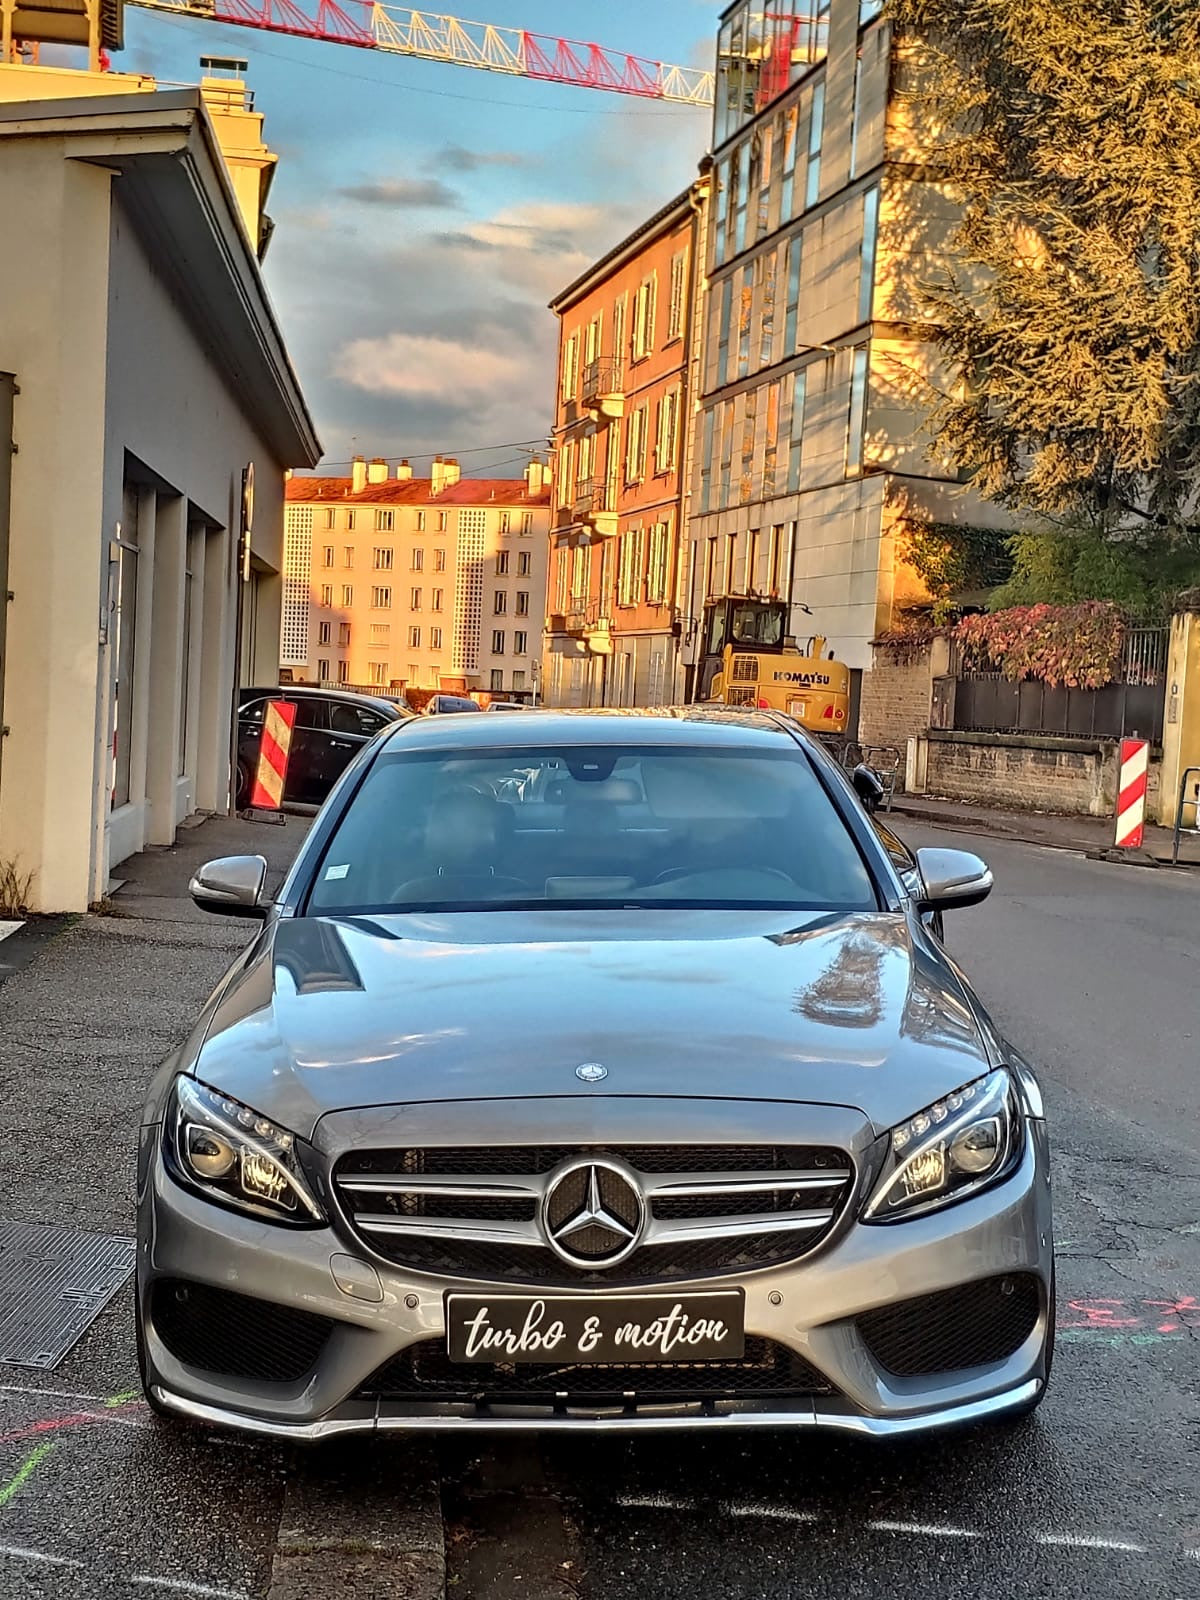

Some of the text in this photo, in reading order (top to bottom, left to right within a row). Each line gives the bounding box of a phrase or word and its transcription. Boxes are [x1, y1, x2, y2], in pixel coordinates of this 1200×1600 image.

[773, 671, 830, 684] KOMATSU
[463, 1300, 729, 1358] turbo & motion
